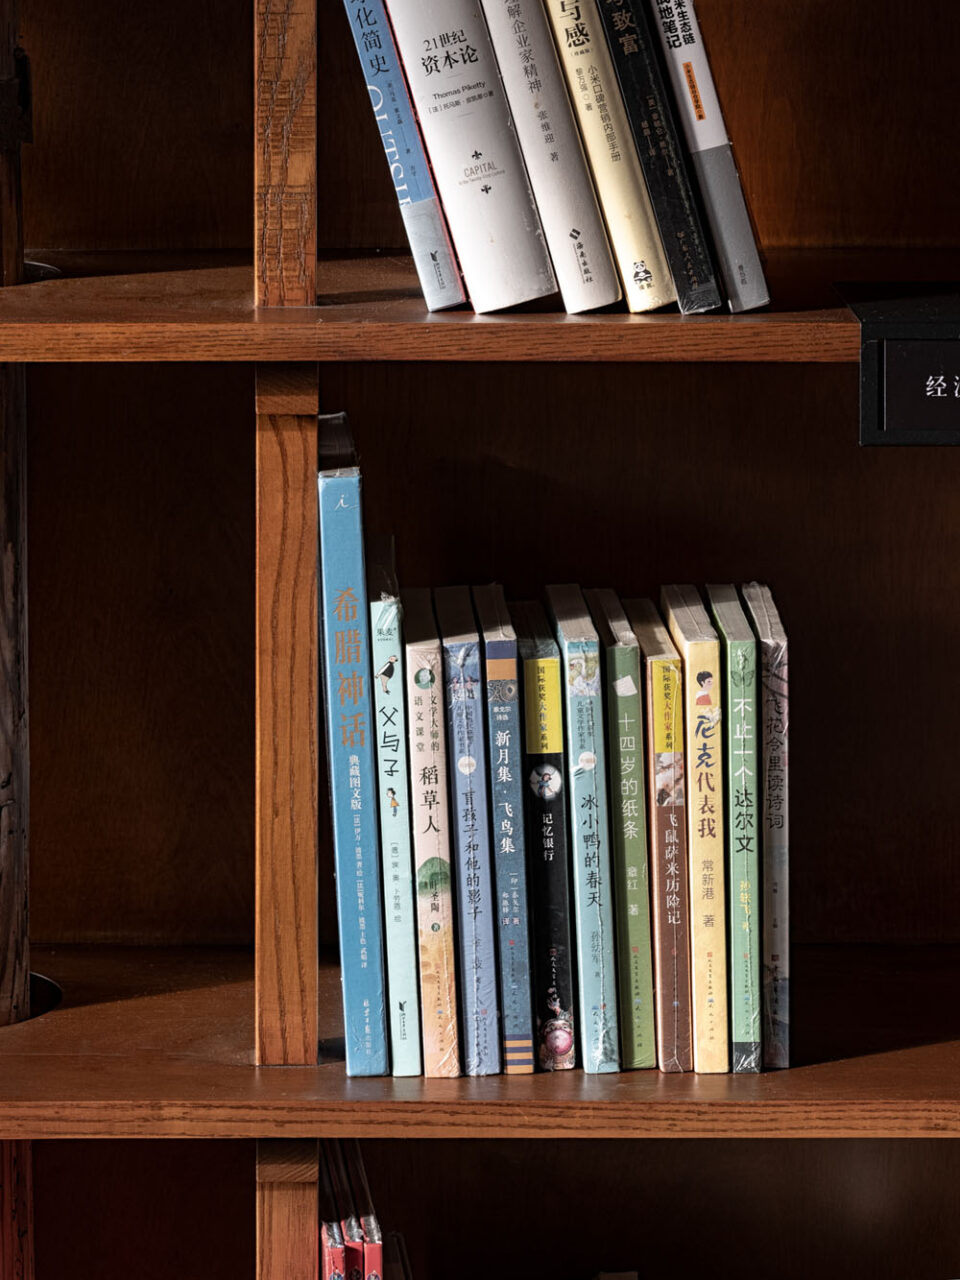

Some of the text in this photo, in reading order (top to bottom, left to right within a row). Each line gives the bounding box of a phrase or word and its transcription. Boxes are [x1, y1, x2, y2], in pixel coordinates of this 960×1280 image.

[421, 45, 479, 77] 资本论
[423, 29, 468, 52] 21世纪
[432, 80, 487, 101] Thomas Piketty
[588, 65, 622, 163] 小米口碑营销内部手册
[463, 161, 498, 178] CAPITAL
[538, 109, 560, 163] 张维迎 著
[332, 587, 366, 748] 希腊神话
[379, 706, 400, 777] 父与子
[414, 695, 425, 752] 语文课堂
[429, 695, 440, 752] 文学大师的
[662, 665, 674, 750] 国际获奖大作家系列
[349, 754, 363, 811] 典藏图文版
[495, 730, 516, 854] 新月集·飞鸟集
[618, 712, 639, 840] 十四岁的纸条
[695, 715, 717, 839] 尼克代表我
[733, 698, 755, 853] 不止一个达尔文
[766, 695, 785, 829] 飞花令里读诗词
[419, 765, 441, 834] 稻草人
[461, 787, 483, 921] 盲孩子和他的影子
[542, 813, 554, 862] 记忆银行
[581, 794, 603, 908] 冰小鸭的春天
[664, 812, 681, 925] 飞鼠萨米历险记
[429, 878, 440, 913] 叶圣陶
[627, 866, 639, 916] 章红 著
[702, 860, 715, 928] 常新港 著
